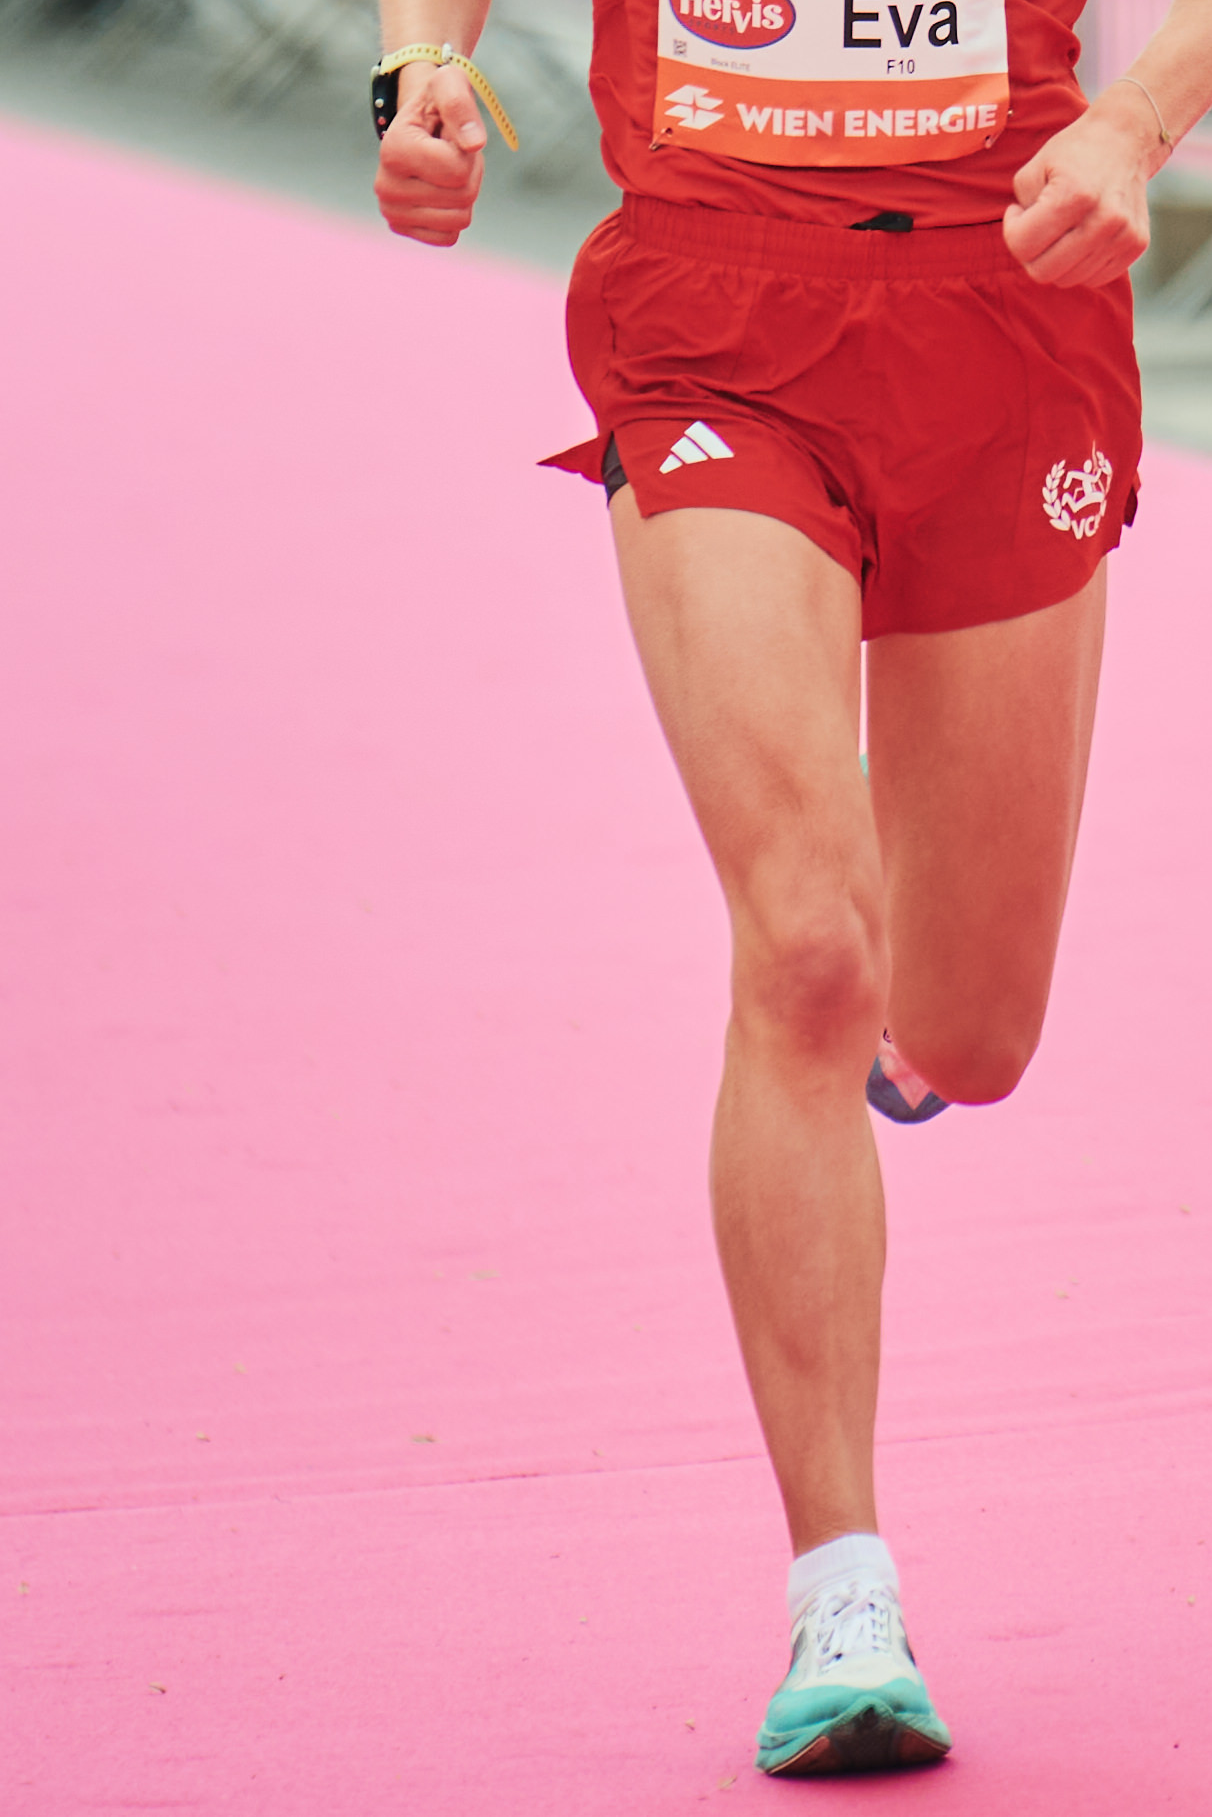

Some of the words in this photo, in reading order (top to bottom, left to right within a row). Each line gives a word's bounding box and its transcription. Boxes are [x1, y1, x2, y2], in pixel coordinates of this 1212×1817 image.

[886, 59, 916, 75] F10
[736, 103, 833, 137] WIEN
[844, 104, 998, 138] ENERGIE
